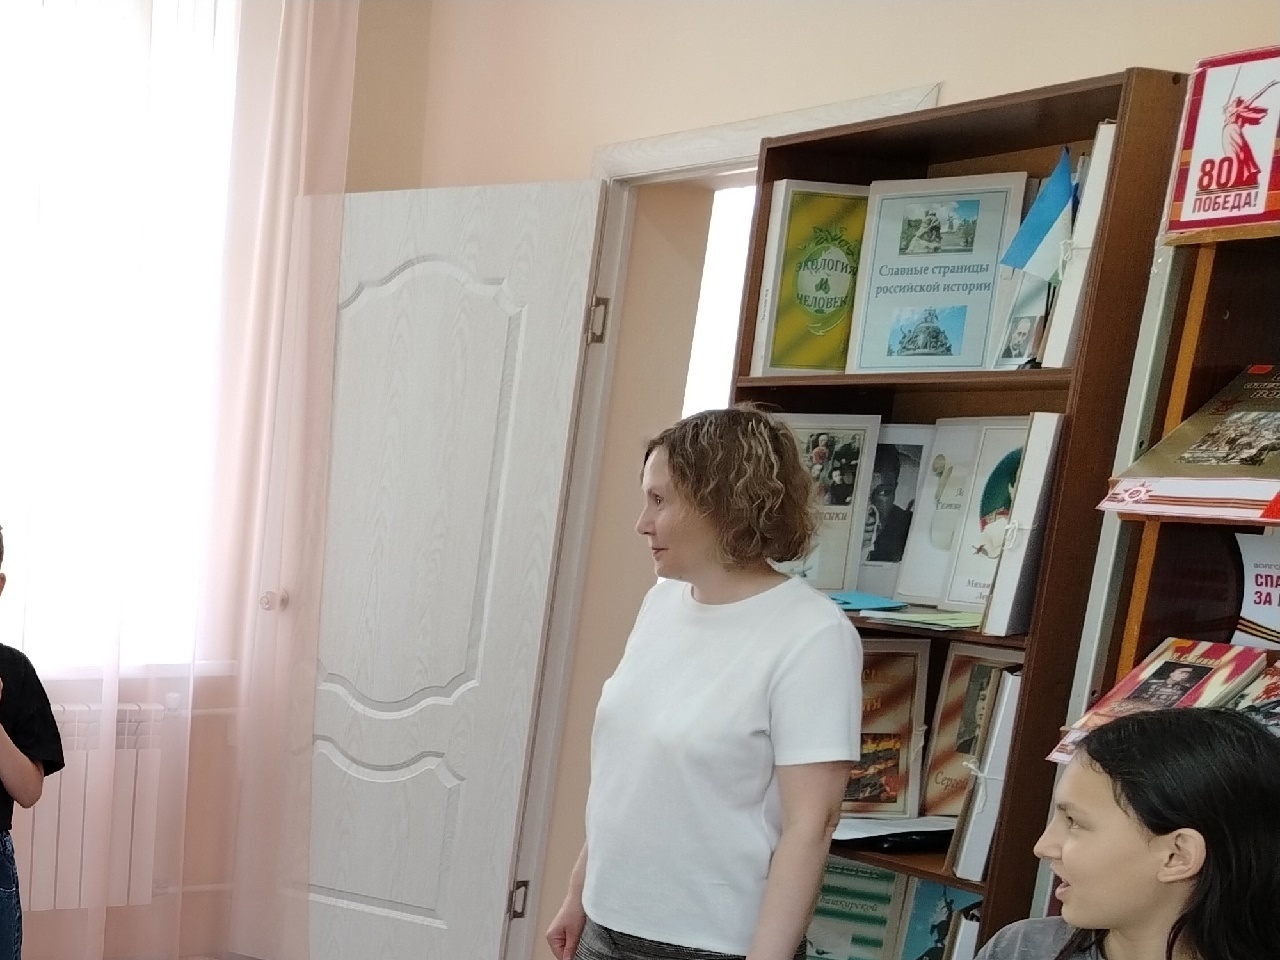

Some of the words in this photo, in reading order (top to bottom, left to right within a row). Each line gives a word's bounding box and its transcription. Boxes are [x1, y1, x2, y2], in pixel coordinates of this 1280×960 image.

[1198, 156, 1233, 190] 80
[1192, 191, 1259, 214] ПОБЕДА!
[796, 258, 858, 276] ЭКОЛОГИЯ
[878, 264, 929, 277] Славные
[931, 262, 990, 277] страницы
[875, 280, 940, 298] российской
[942, 281, 992, 295] истории
[796, 292, 849, 309] ЧЕЛОВЕК
[1253, 590, 1272, 606] ЗА
